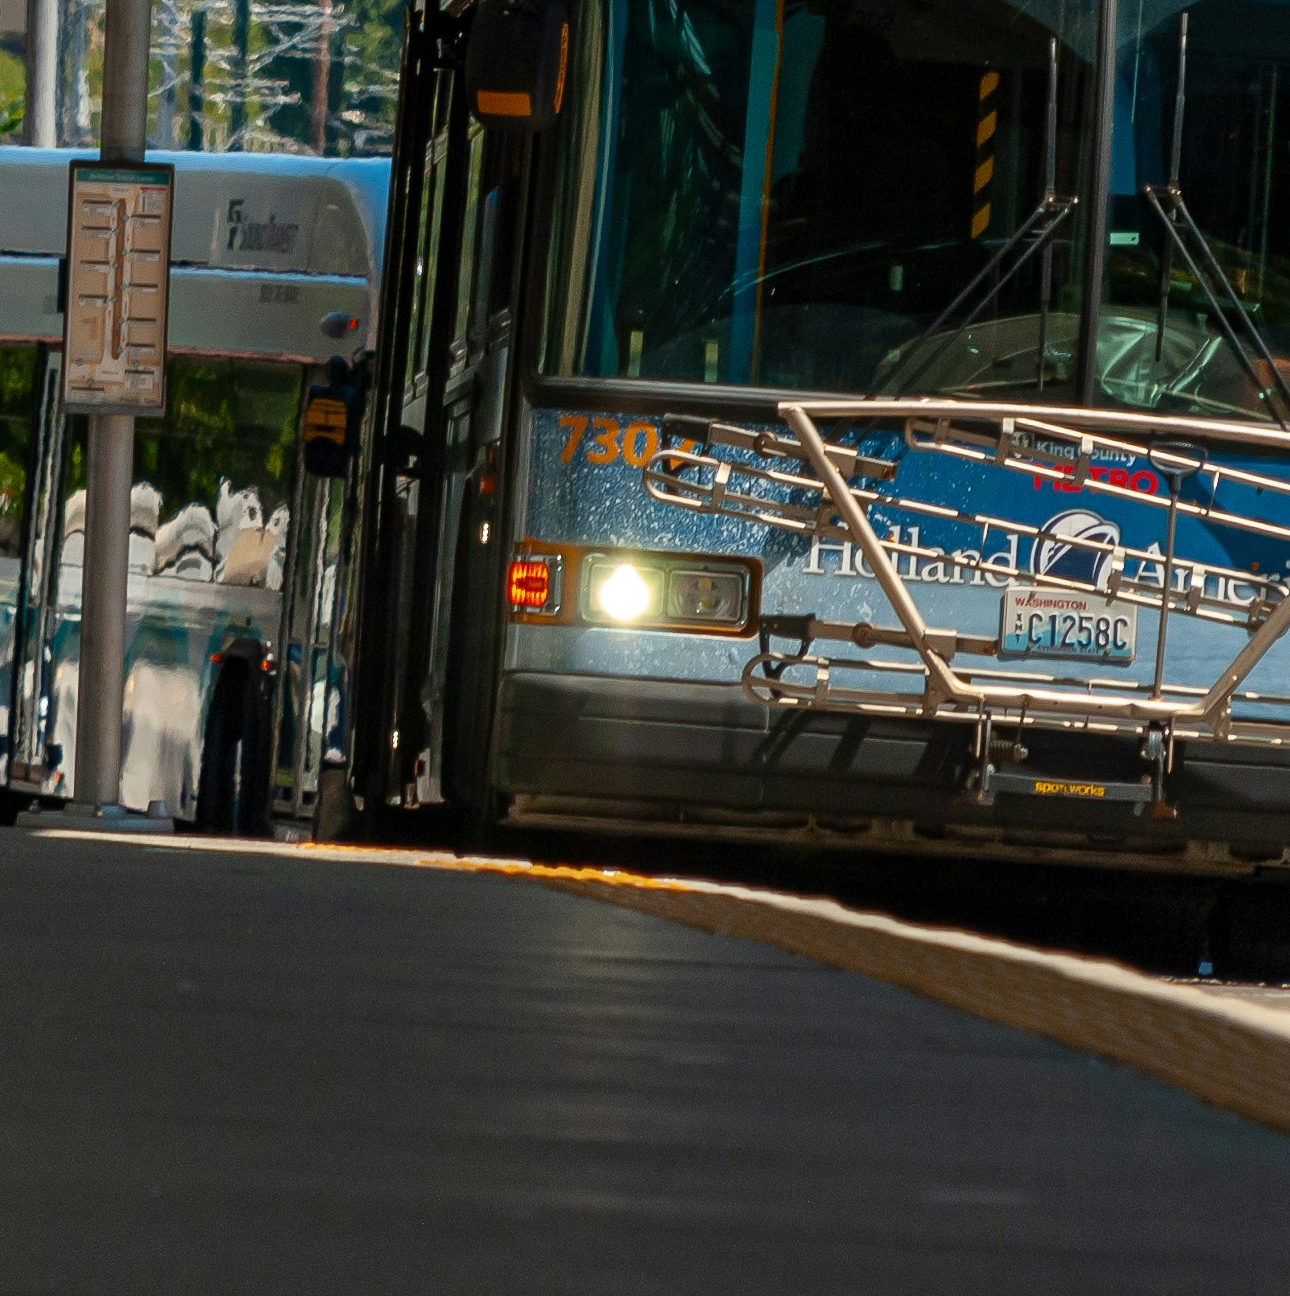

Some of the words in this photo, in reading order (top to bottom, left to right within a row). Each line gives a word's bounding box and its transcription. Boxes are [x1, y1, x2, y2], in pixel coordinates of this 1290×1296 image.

[1037, 440, 1075, 459] King
[1033, 463, 1158, 495] METRO
[1014, 597, 1087, 610] WASHINGTON
[1028, 613, 1128, 650] C1258C
